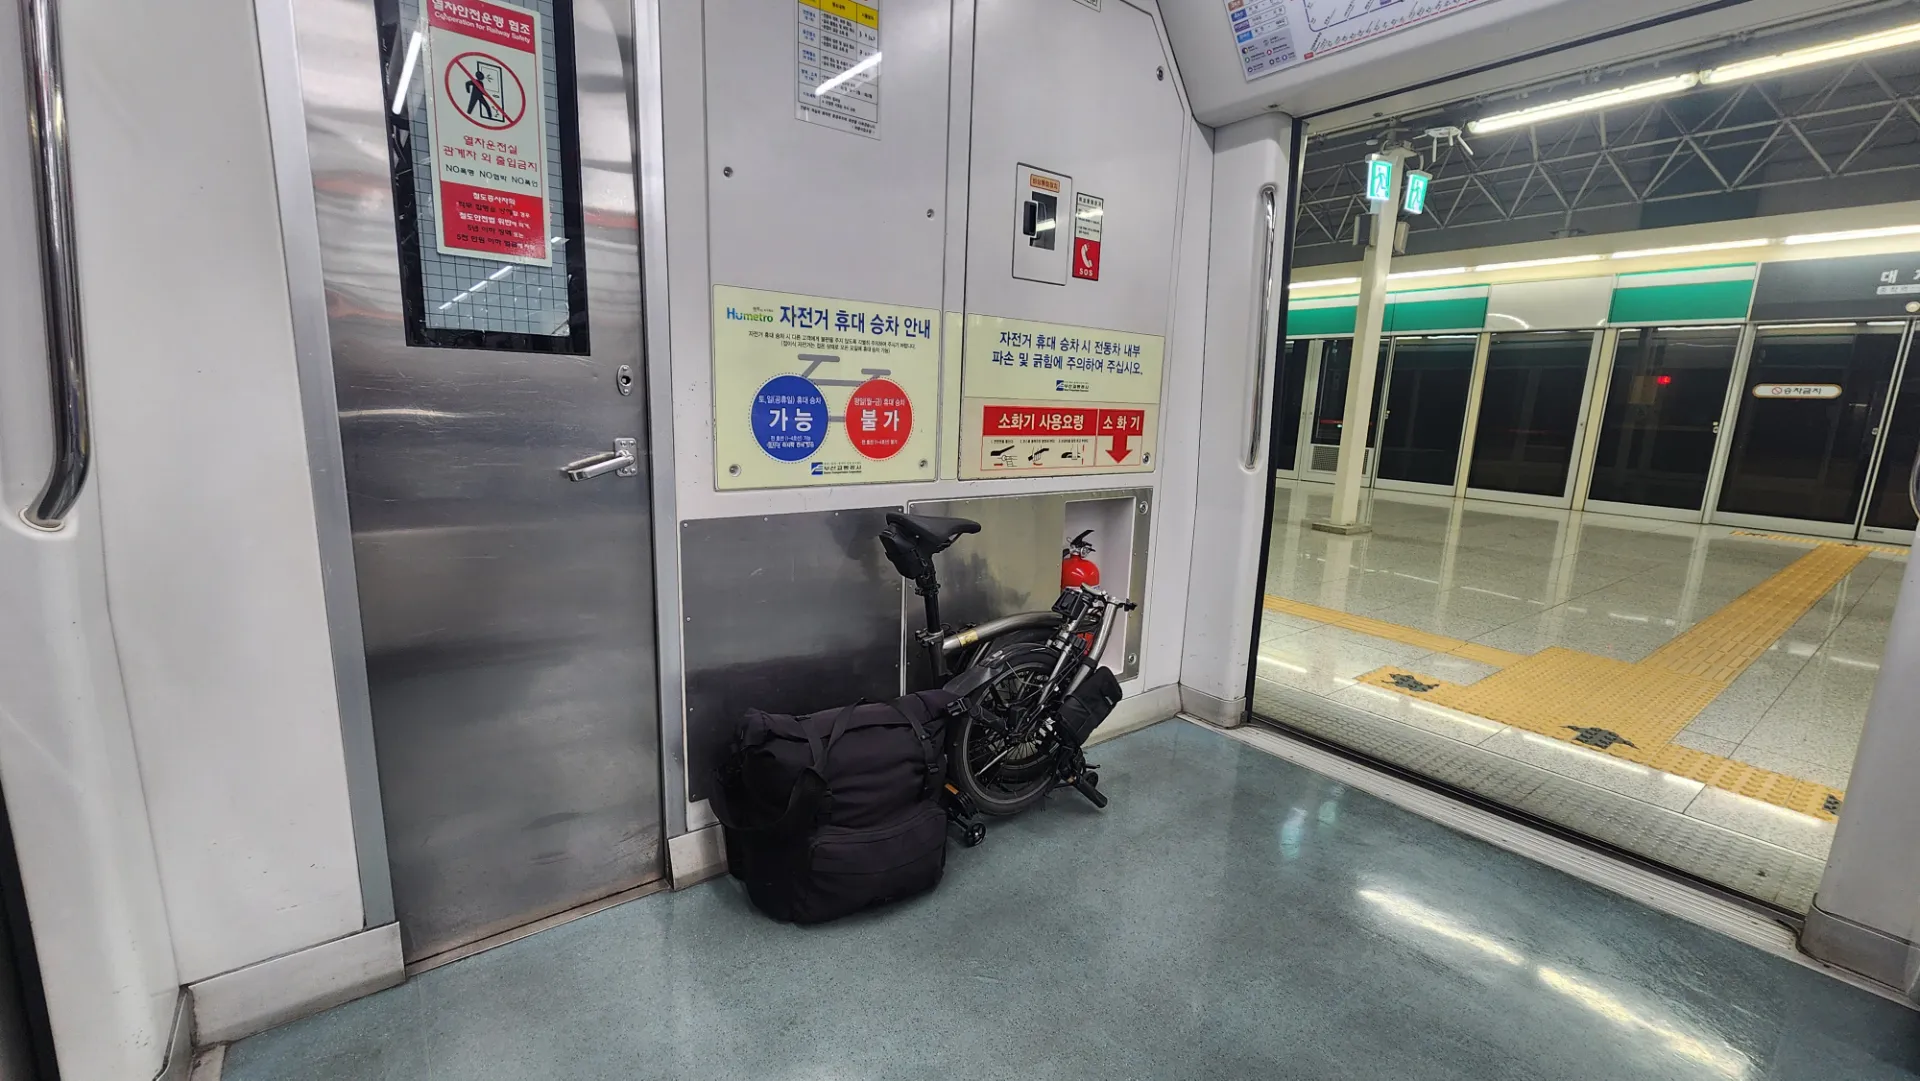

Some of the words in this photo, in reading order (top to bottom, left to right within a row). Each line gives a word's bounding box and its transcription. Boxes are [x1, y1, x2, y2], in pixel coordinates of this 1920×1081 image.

[476, 23, 485, 31] for
[486, 26, 510, 38] Railway
[512, 33, 530, 44] Safety
[508, 20, 530, 35] 협조
[464, 135, 518, 155] 열차운전실
[443, 145, 476, 160] 관계자
[481, 152, 492, 164] 외
[496, 156, 538, 172] 출입금지
[1080, 268, 1094, 276] SOS
[726, 307, 774, 322] Humetro
[780, 305, 828, 330] 자전거
[835, 309, 864, 334] 휴대
[870, 314, 900, 336] 승차
[904, 317, 931, 339] 안내
[999, 331, 1032, 348] 자전거
[1036, 334, 1056, 350] 휴대
[1060, 337, 1080, 353] 승차
[1082, 340, 1091, 354] 시
[1094, 341, 1121, 356] 전동차
[1124, 344, 1140, 358] 내부
[992, 350, 1014, 366] 파손
[1018, 352, 1028, 368] 및
[1032, 353, 1063, 370] 긁힘에
[1066, 356, 1104, 373] 주의하여
[1106, 359, 1143, 376] 주십시오.
[796, 396, 808, 404] 휴대
[810, 396, 822, 404] 승차
[884, 398, 894, 406] 휴대
[998, 413, 1035, 430] 소화기
[1039, 413, 1084, 431] 사용요령
